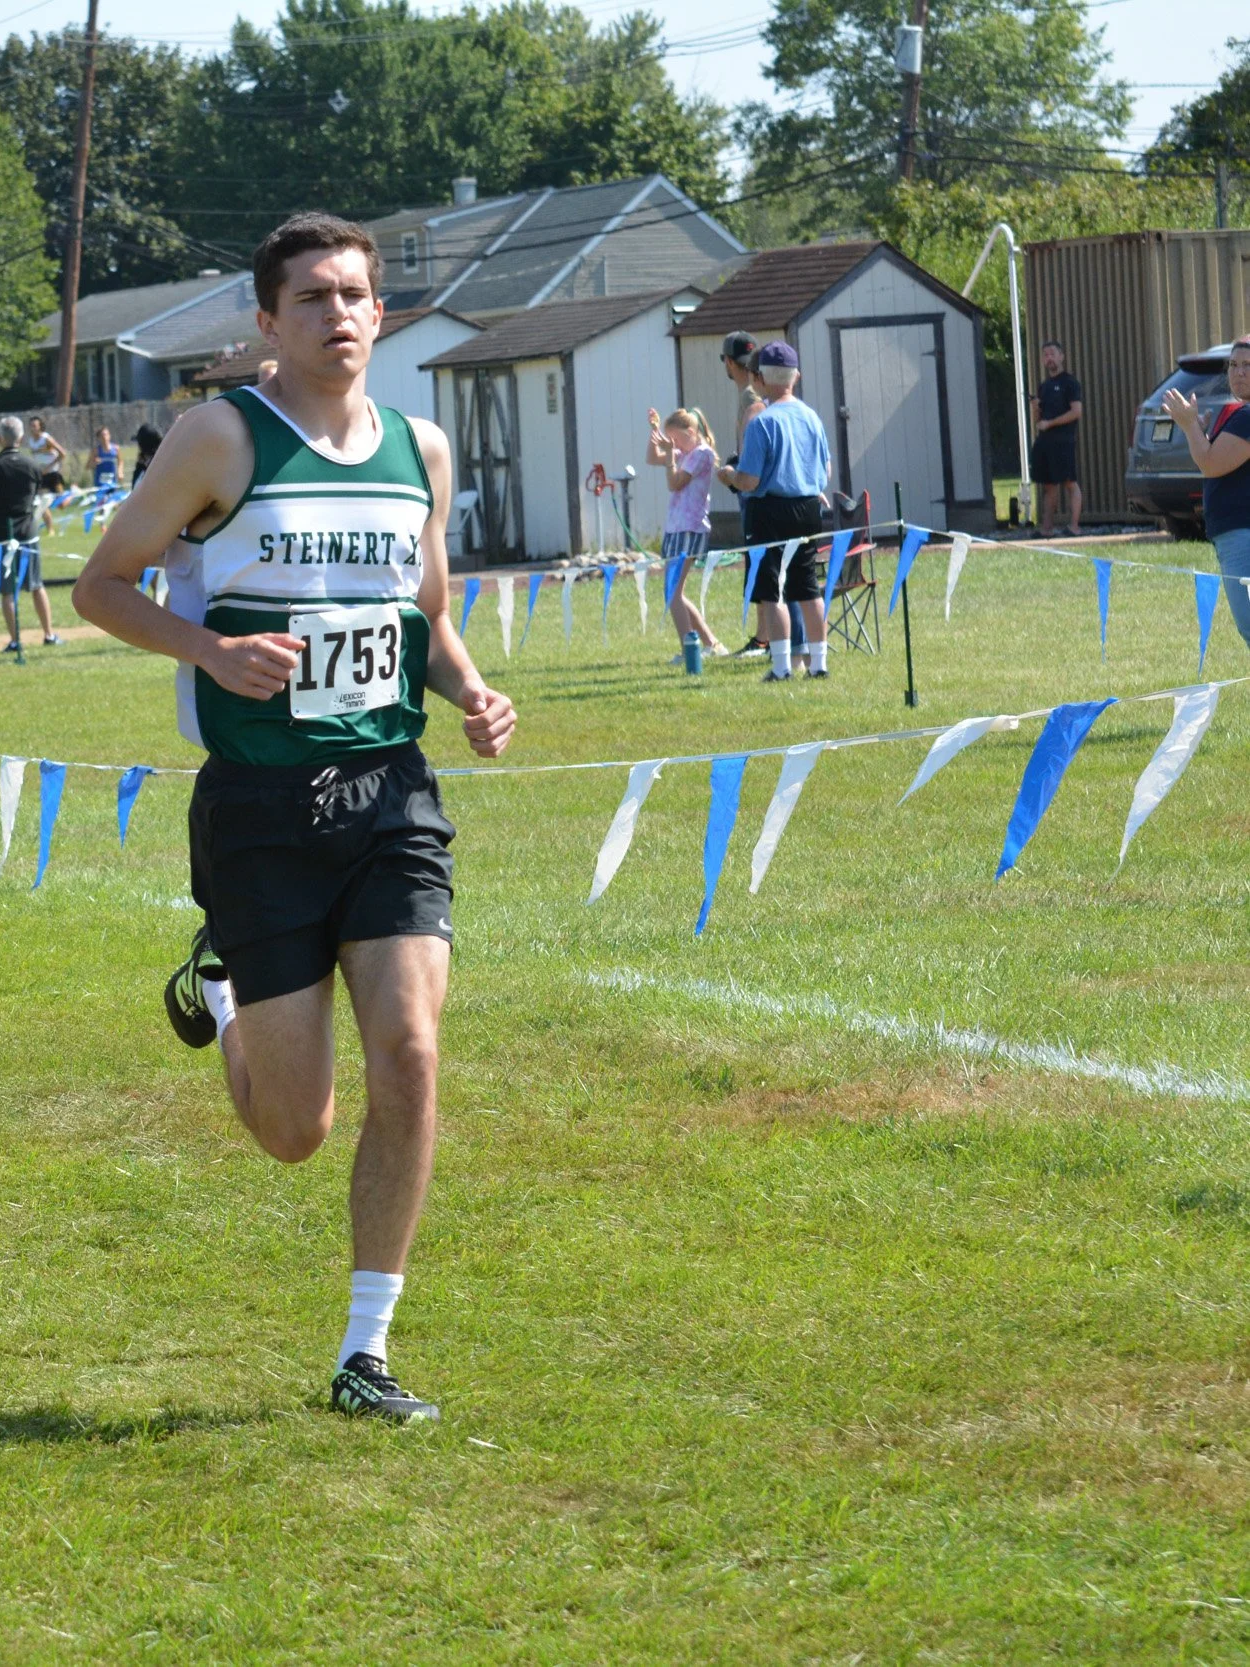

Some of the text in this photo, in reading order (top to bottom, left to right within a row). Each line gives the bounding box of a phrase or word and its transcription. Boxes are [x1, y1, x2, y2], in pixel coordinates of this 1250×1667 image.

[259, 531, 422, 567] STEINERT X
[295, 623, 398, 691] 1753
